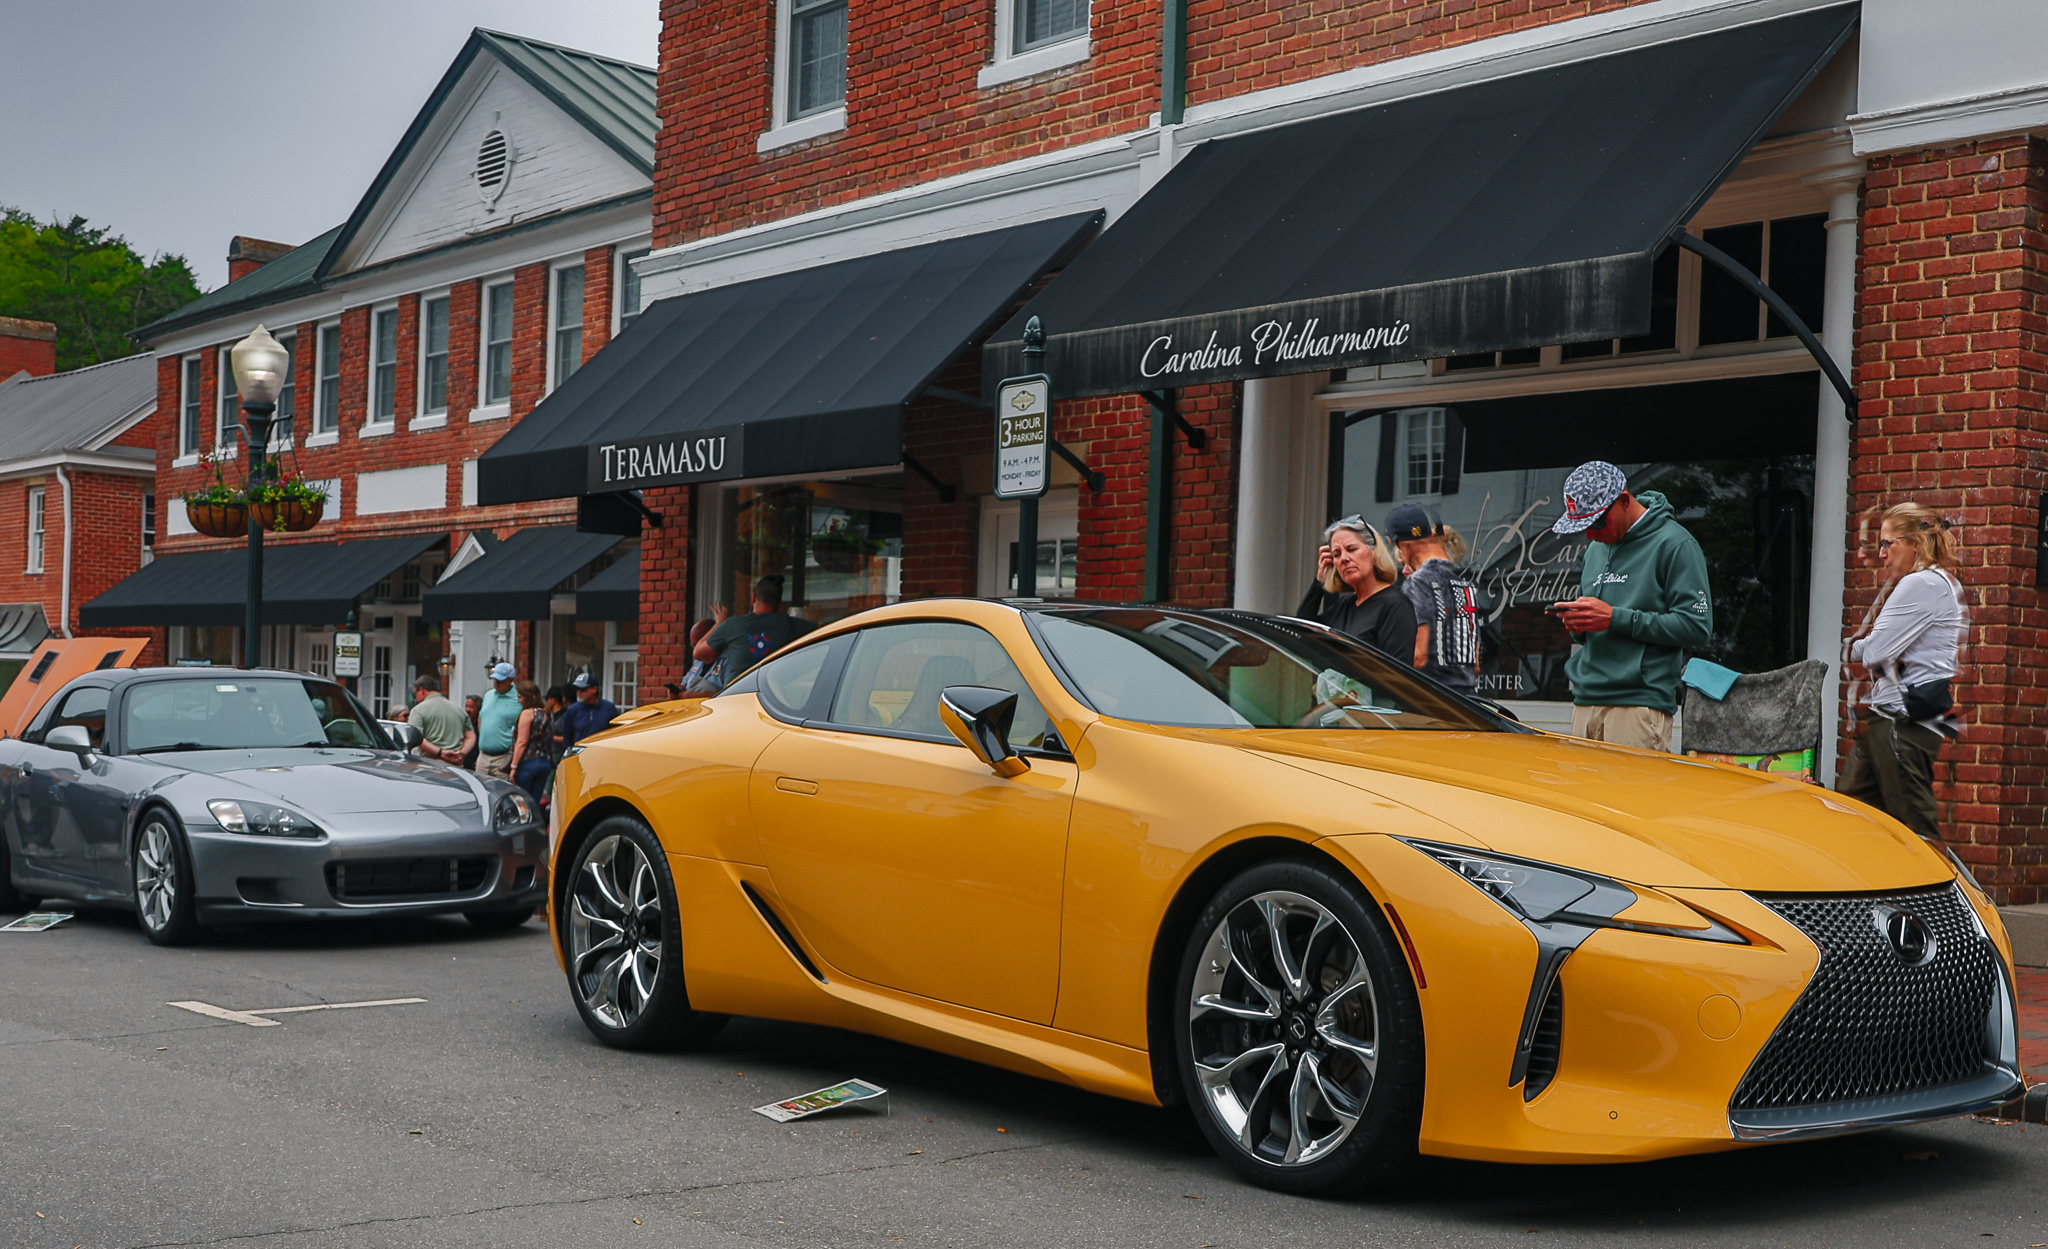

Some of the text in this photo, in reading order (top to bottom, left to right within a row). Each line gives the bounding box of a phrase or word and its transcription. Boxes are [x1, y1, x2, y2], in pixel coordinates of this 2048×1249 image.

[1139, 317, 1411, 378] Carolina Philharmonic
[1002, 417, 1041, 447] 3 HOUR
[1012, 431, 1043, 443] PARKING
[600, 436, 726, 482] TERAMASU
[1001, 472, 1022, 480] MONDAY
[1025, 469, 1042, 478] FRIDAY
[1528, 527, 1588, 566] Car
[1506, 568, 1581, 607] Philha
[1477, 674, 1524, 690] ENTER
